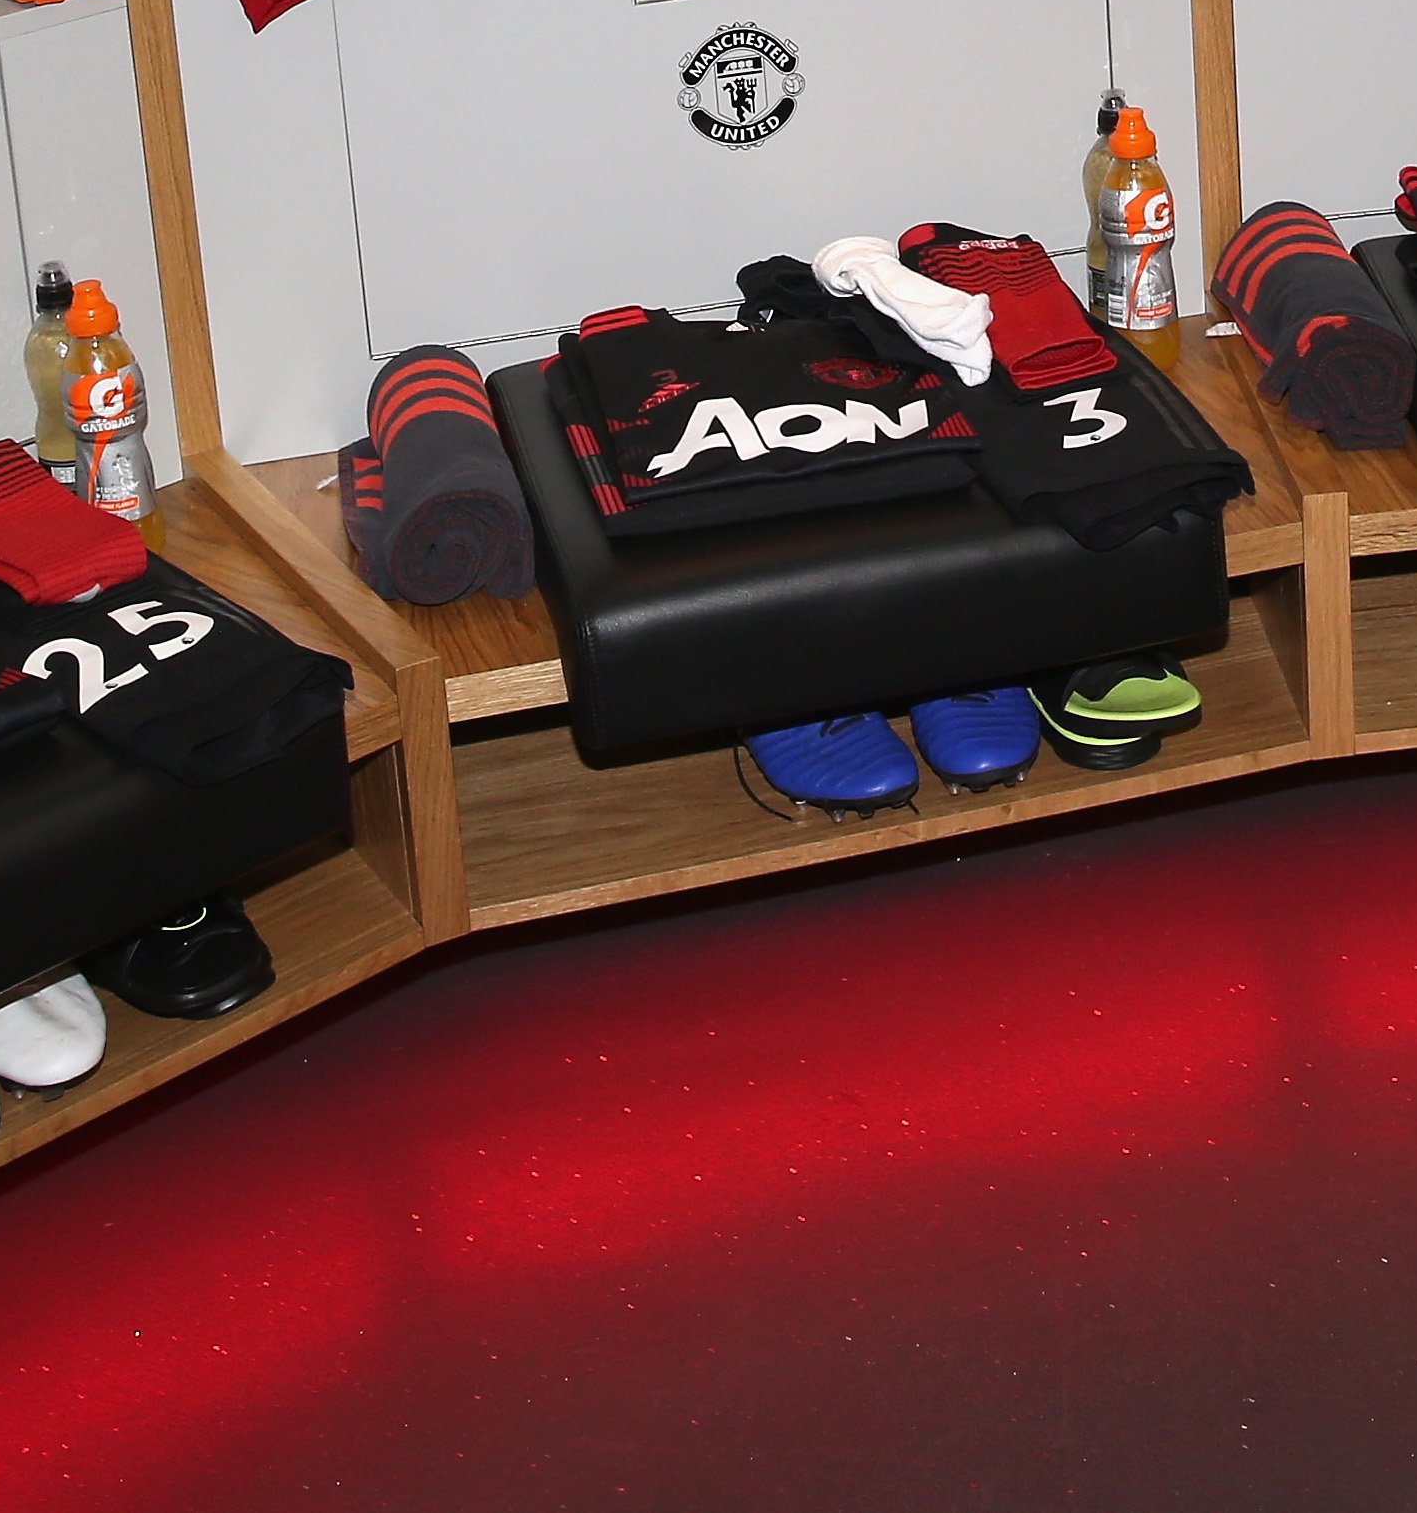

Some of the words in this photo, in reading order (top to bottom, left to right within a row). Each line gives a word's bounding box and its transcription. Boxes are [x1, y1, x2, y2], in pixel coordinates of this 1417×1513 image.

[689, 32, 789, 78] MANCHESTER
[710, 115, 780, 141] UNITED
[1144, 192, 1170, 230] G
[89, 376, 125, 417] G
[1042, 387, 1128, 449] 3
[80, 414, 136, 433] GATORADE
[646, 396, 929, 479] AON
[21, 600, 215, 715] 25
